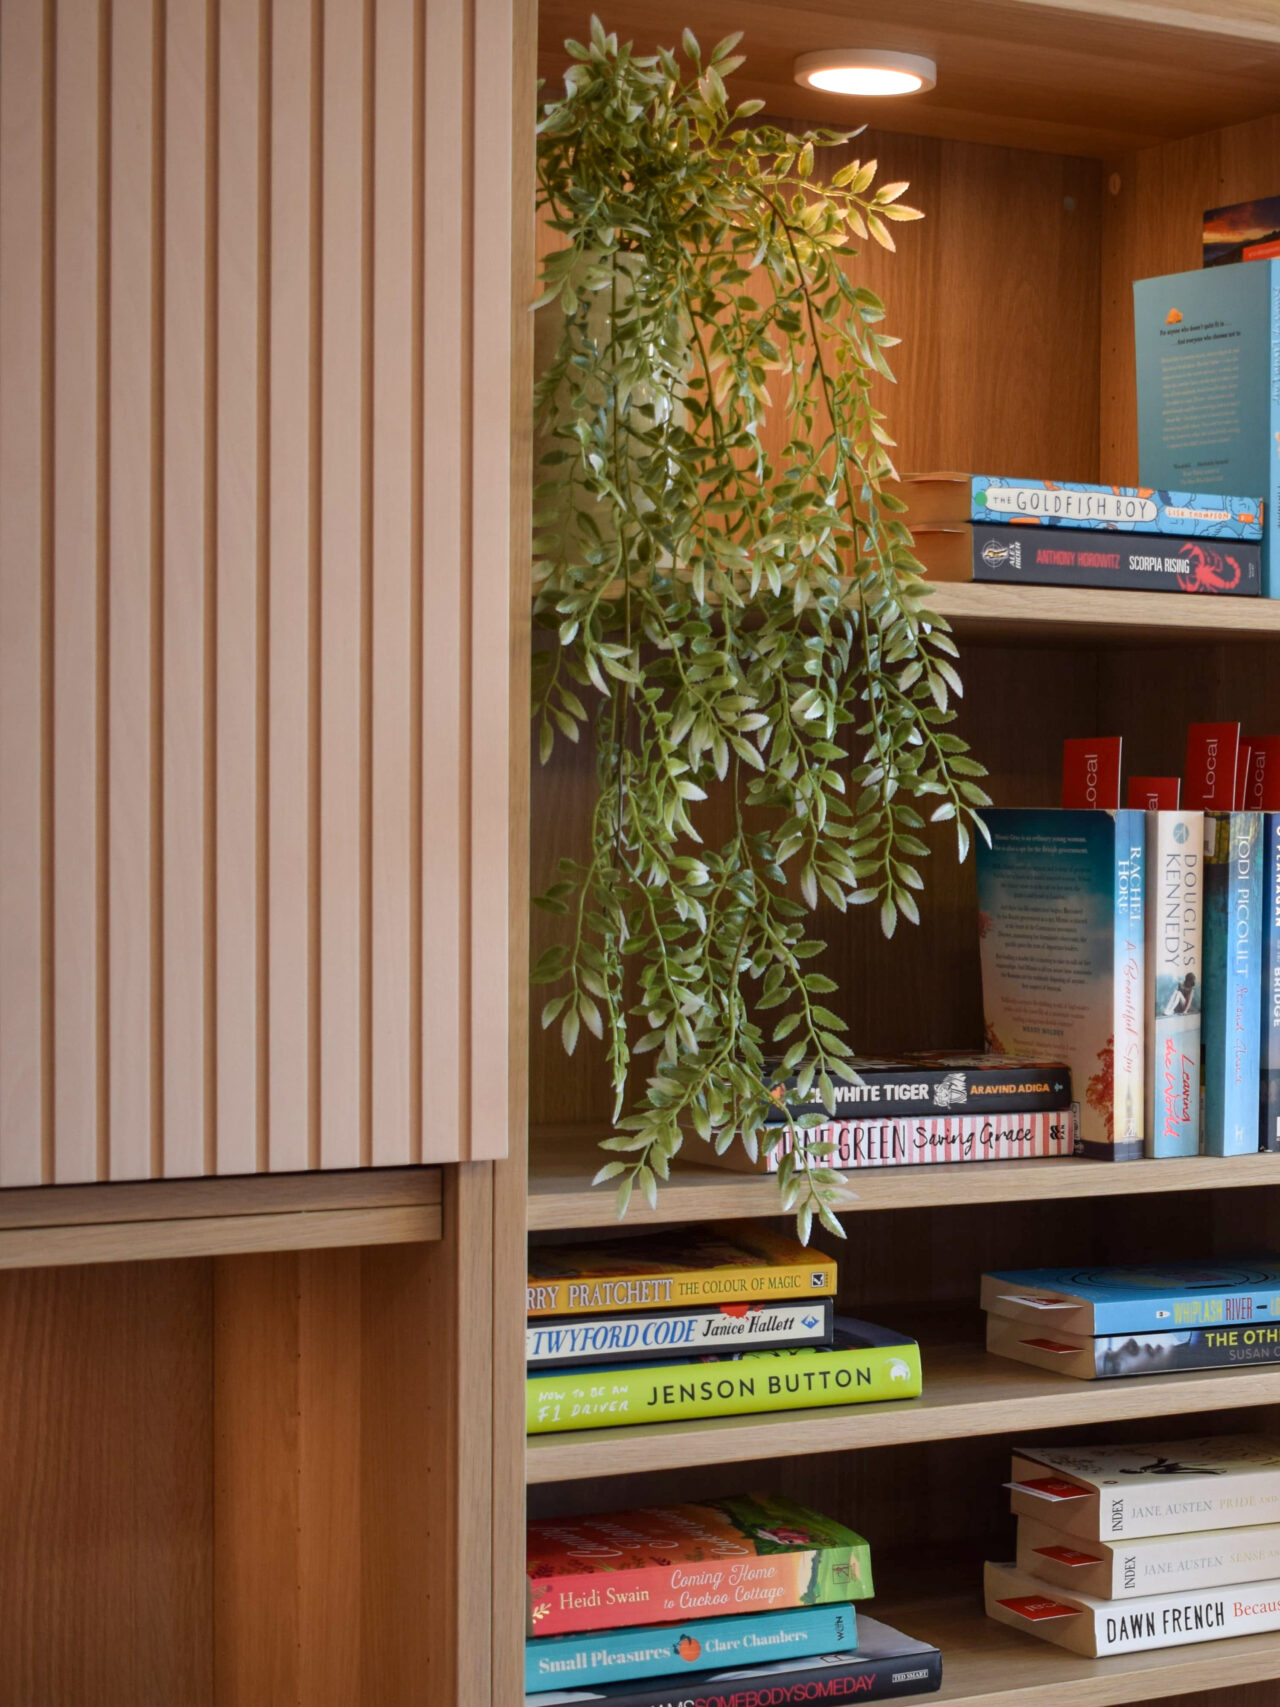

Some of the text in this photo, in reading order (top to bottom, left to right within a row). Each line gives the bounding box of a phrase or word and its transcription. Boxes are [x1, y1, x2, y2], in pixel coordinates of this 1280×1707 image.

[993, 491, 1148, 520] THE GOLDFISH BOY
[1188, 510, 1231, 520] THOMPSON
[1014, 541, 1022, 570] RIDER
[1035, 549, 1121, 570] ANTHONY HOROWITZ
[1128, 554, 1190, 574] SCORPIA RISING
[1202, 737, 1219, 800] Local
[1117, 861, 1130, 915] HORE
[1129, 847, 1142, 927] RACHEL
[1164, 853, 1182, 967] KENNEDY
[1182, 854, 1198, 967] DOUGLAS
[1235, 835, 1251, 978] JODI PICOULT
[834, 1085, 881, 1103] WHITE
[884, 1083, 930, 1101] TIGER
[970, 1084, 1017, 1095] ARAVIND
[1018, 1083, 1050, 1093] ADIGA
[1175, 1053, 1195, 1123] Leaving
[526, 1275, 801, 1310] RRY PRATCHETT THE COLOUR OF MAGIC
[532, 1314, 796, 1356] TWYFORD CODE Janice Hallett
[1205, 1332, 1239, 1347] THE
[1229, 1348, 1270, 1361] SUSAN
[537, 1391, 566, 1402] HOW
[590, 1386, 606, 1398] BE
[612, 1385, 629, 1395] AN
[646, 1366, 873, 1406] JENSON BUTTON
[537, 1400, 629, 1423] F1 DRIVER
[1111, 1498, 1124, 1532] INDEX
[670, 1564, 777, 1591] Coming Home
[1124, 1555, 1136, 1590] INDEX
[559, 1586, 650, 1611] Heidi Swain
[663, 1585, 785, 1610] to Cuckoo Cottage
[1106, 1610, 1156, 1644] DAWN
[1162, 1600, 1226, 1635] FRENCH
[538, 1629, 808, 1675] Small Pleasures Clare Chambers
[893, 1670, 928, 1682] TED SMART
